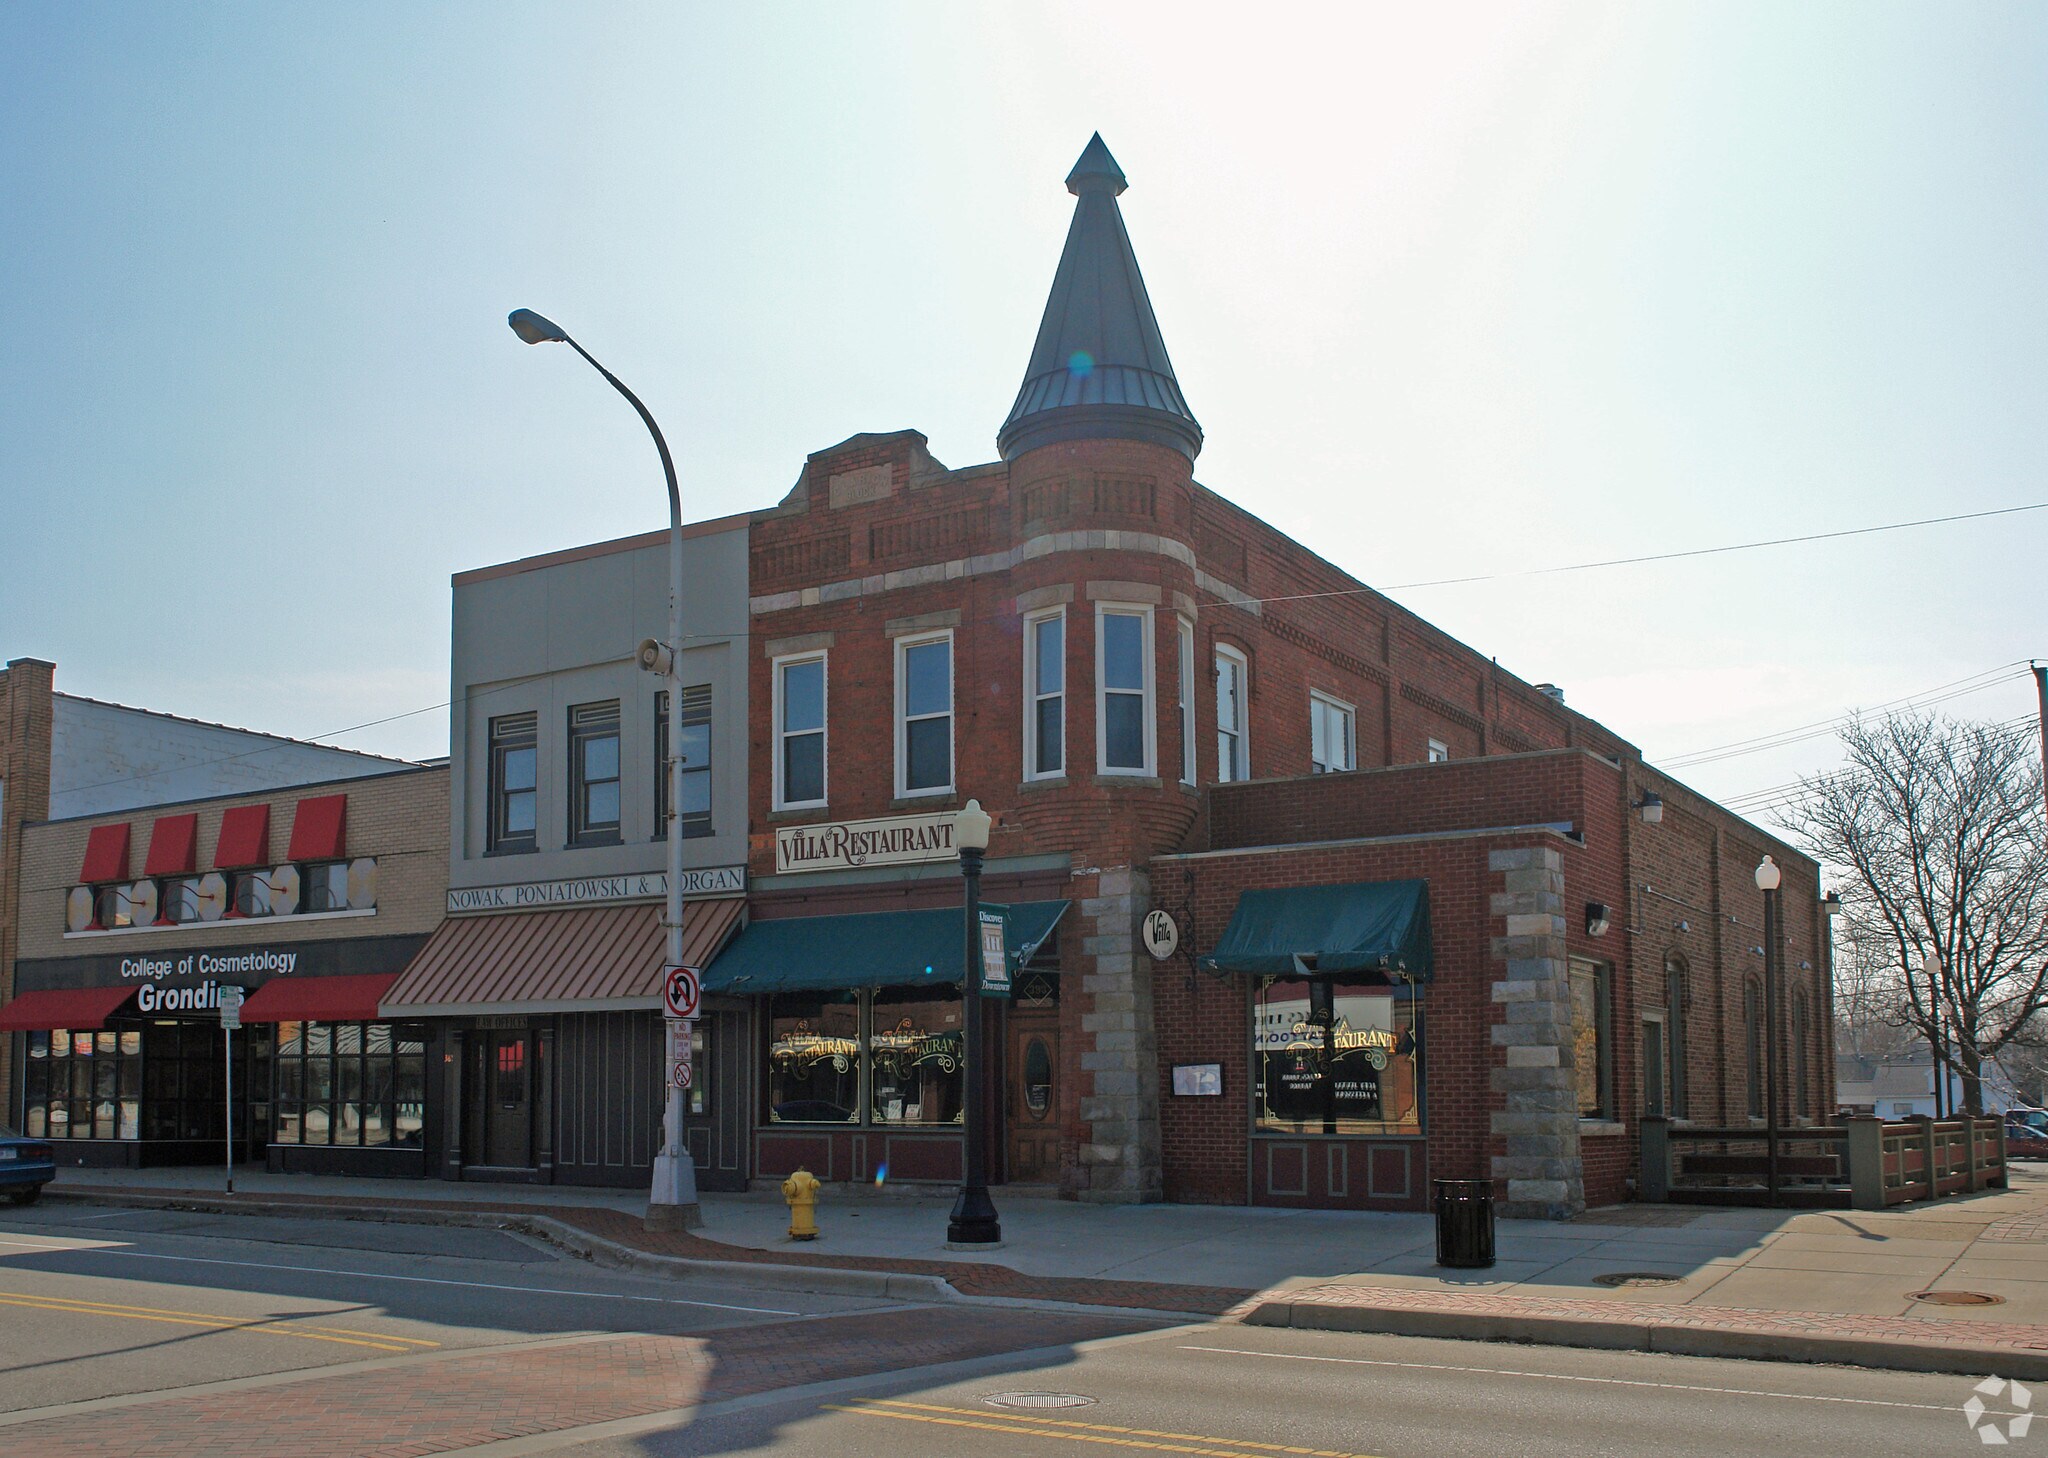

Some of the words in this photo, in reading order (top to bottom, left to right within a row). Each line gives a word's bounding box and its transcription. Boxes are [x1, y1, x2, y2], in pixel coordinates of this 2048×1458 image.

[780, 829, 830, 868] VILLA
[825, 824, 954, 866] RESTAURANT
[516, 877, 628, 904] PONIATOWSKI
[638, 876, 649, 894] &
[979, 910, 1003, 923] Discover
[1149, 912, 1171, 945] Villa
[121, 958, 173, 980] College
[178, 955, 194, 975] of
[199, 950, 297, 974] Cosmetology
[138, 980, 245, 1012] Grondis
[981, 979, 1011, 991] Downtown
